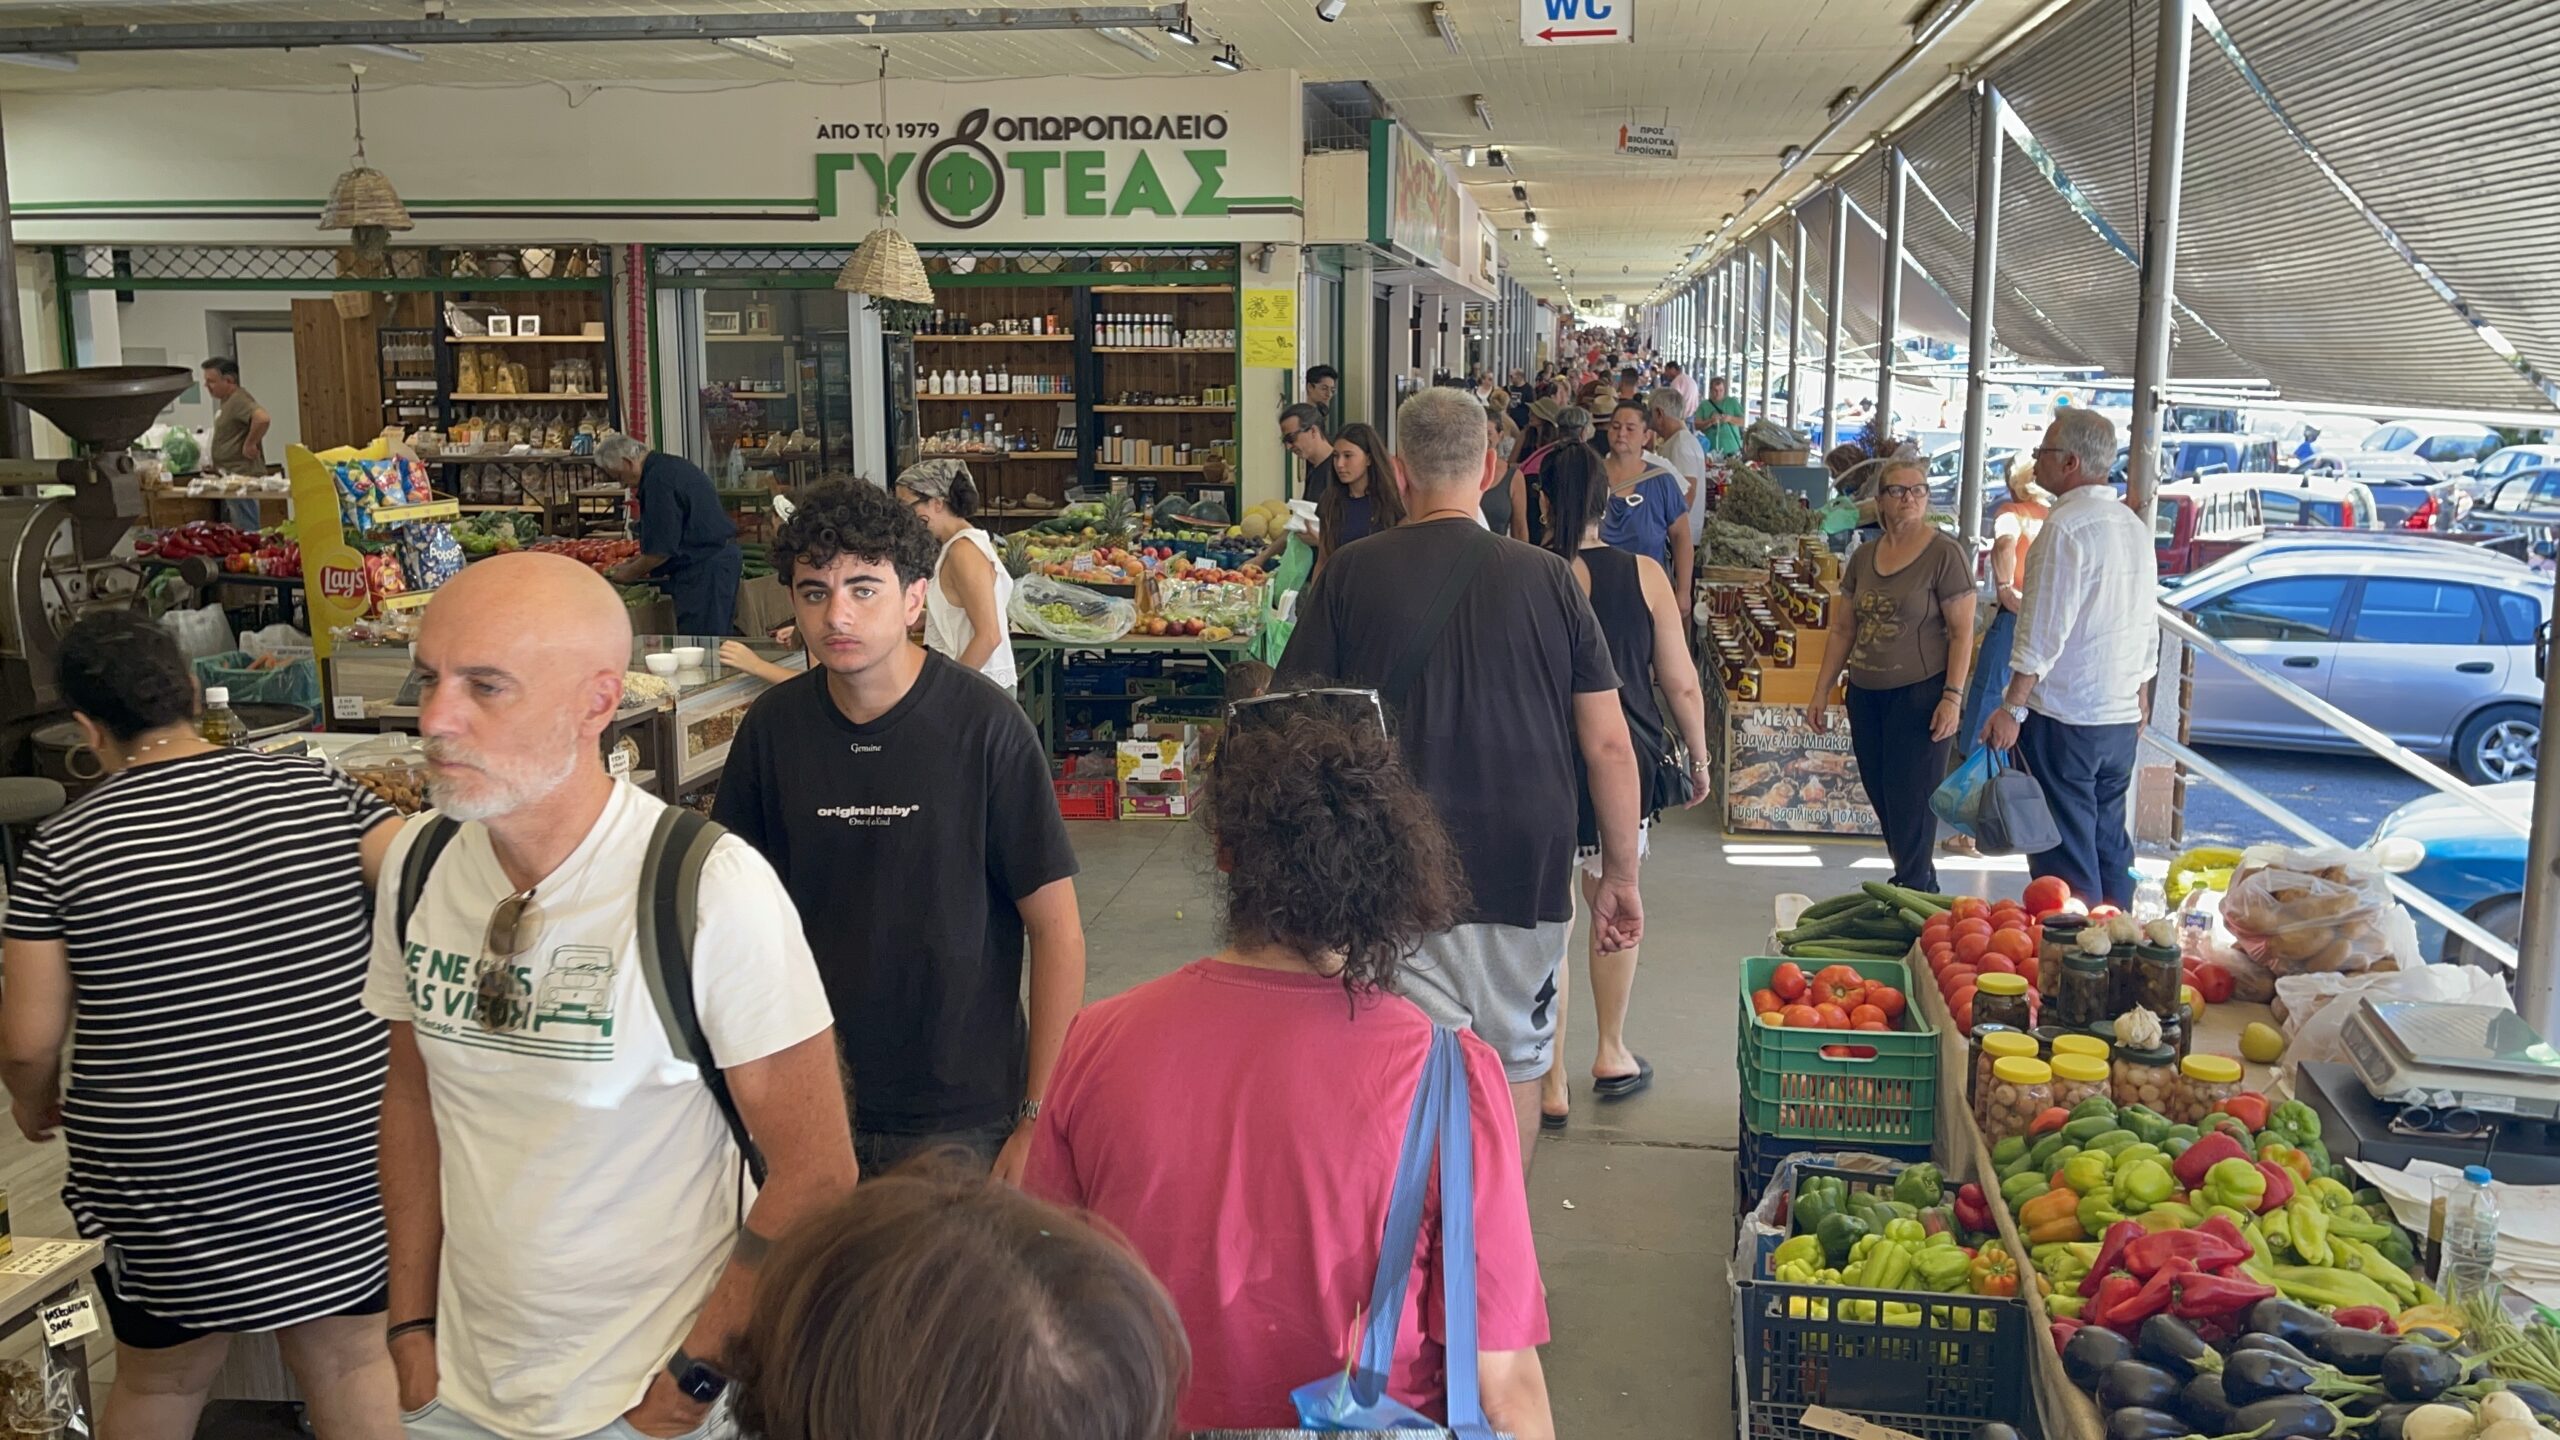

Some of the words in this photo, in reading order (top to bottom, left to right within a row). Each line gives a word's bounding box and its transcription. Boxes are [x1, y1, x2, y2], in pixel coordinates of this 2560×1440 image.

[1545, 0, 1612, 20] WC
[817, 123, 860, 139] ΑΠΟ
[864, 123, 890, 139] ΤΟ
[896, 122, 940, 139] 1979
[993, 114, 1228, 142] ΟΠΩΡΟΠΩΛΕΙΟ
[1640, 126, 1664, 136] ΠΡΟΣ
[1627, 135, 1674, 146] ΒΙΟΛΟΓΙΚΑ
[1626, 145, 1673, 156] ΠΡΟΪΟΝΤΑ
[816, 149, 1228, 217] ΓΥΦΤΕΑΣ
[324, 566, 365, 598] Lay's
[817, 806, 876, 818] original
[876, 805, 911, 817] baby
[427, 949, 471, 985] NE
